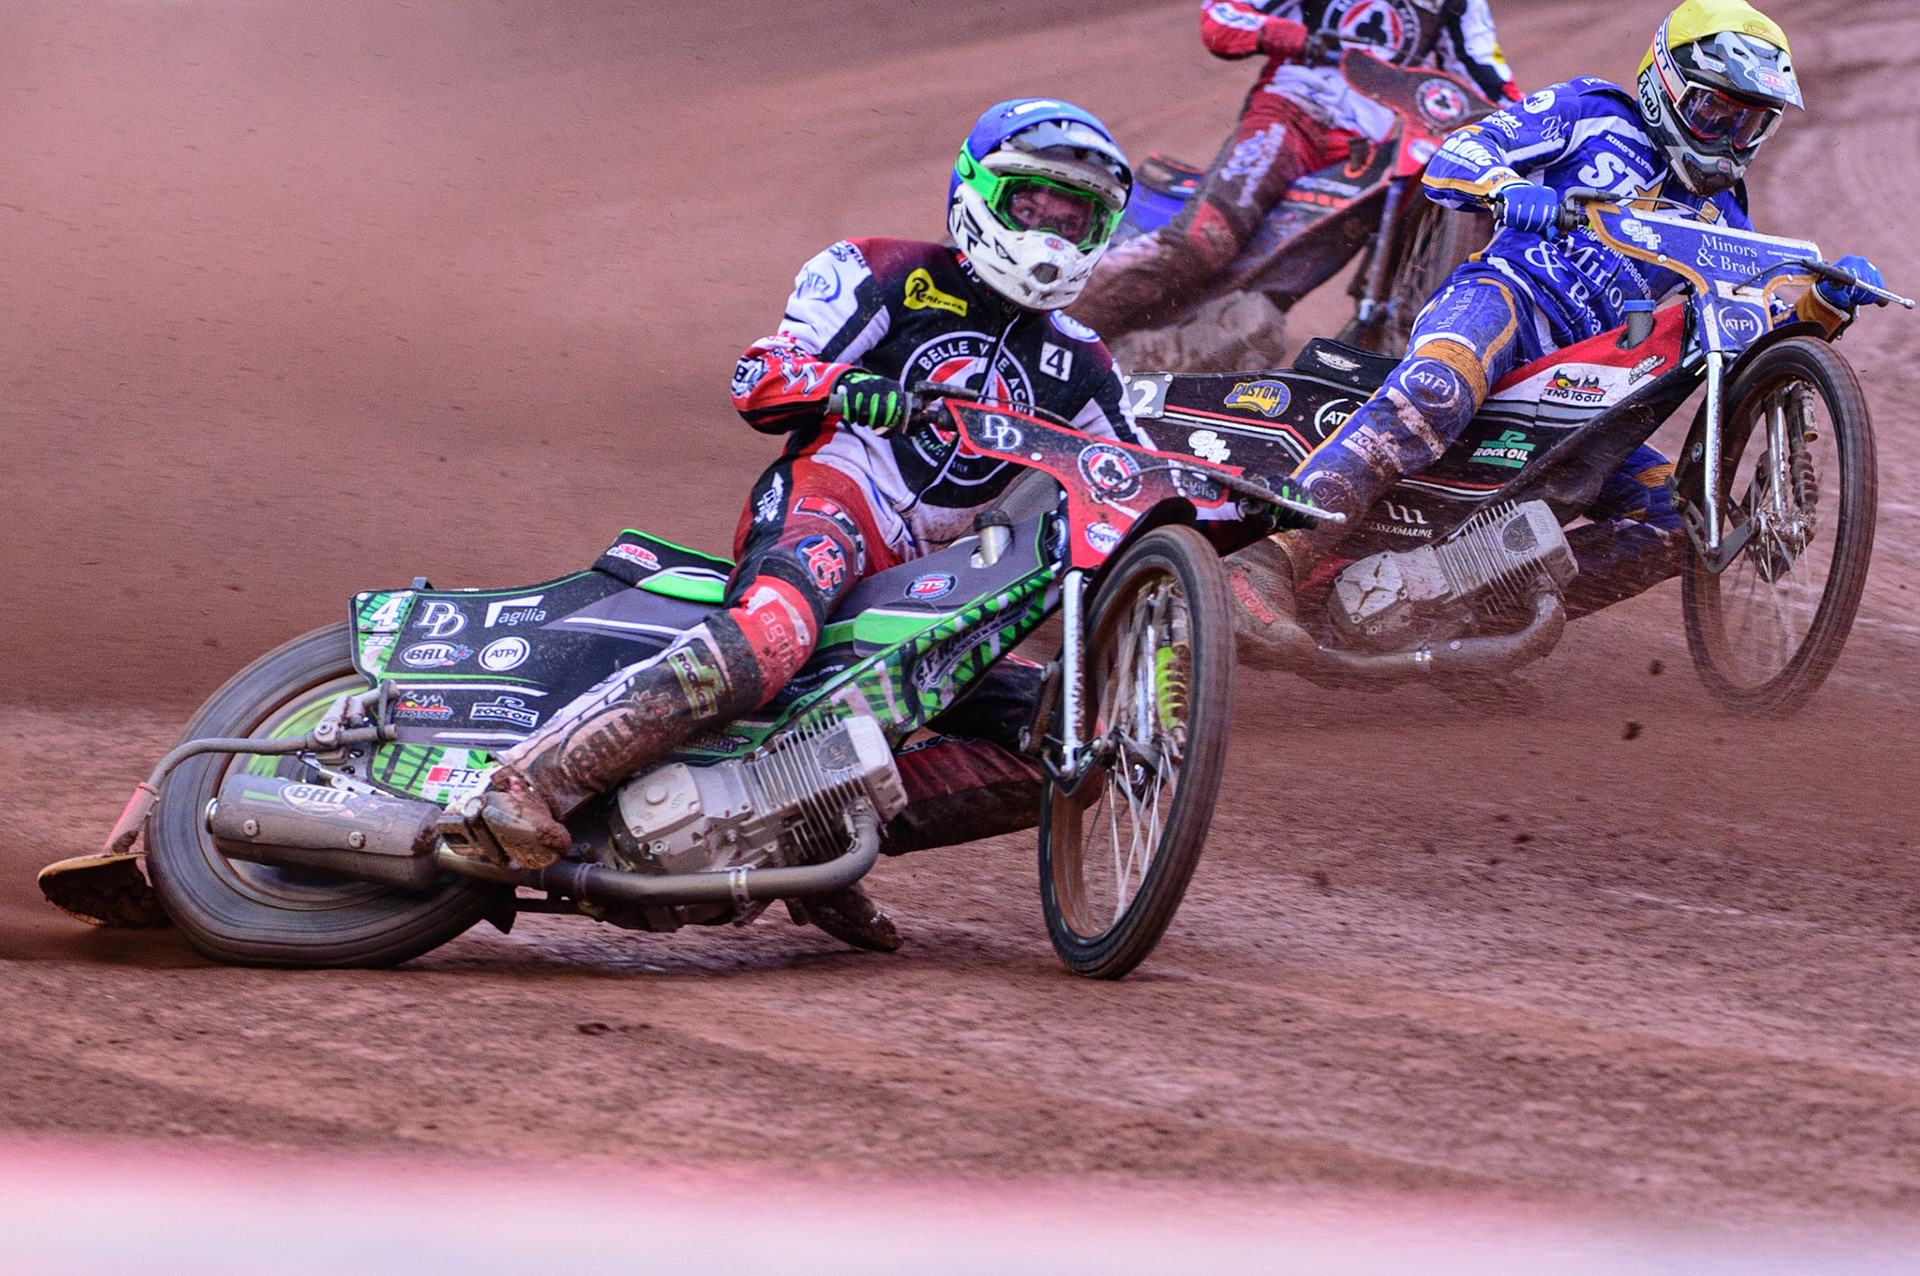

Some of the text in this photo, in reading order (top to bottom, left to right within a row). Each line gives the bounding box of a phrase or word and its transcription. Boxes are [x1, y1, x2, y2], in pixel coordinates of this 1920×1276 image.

[1639, 79, 1660, 117] Arai
[1701, 234, 1758, 258] Minors
[1696, 247, 1717, 268] &
[1725, 318, 1755, 331] ATPI
[918, 340, 970, 371] BELLE
[1046, 348, 1065, 378] 4
[1235, 383, 1281, 401] CUSTOM
[1410, 371, 1451, 397] ATPI
[1131, 379, 1159, 415] 2
[1472, 446, 1529, 461] ROCK OIL
[1370, 522, 1434, 539] ESSEXMARINE
[911, 580, 949, 592] STS
[369, 596, 405, 627] 4
[498, 607, 548, 627] agilia
[489, 648, 519, 660] ATPI
[474, 707, 534, 723] ROCK OIL
